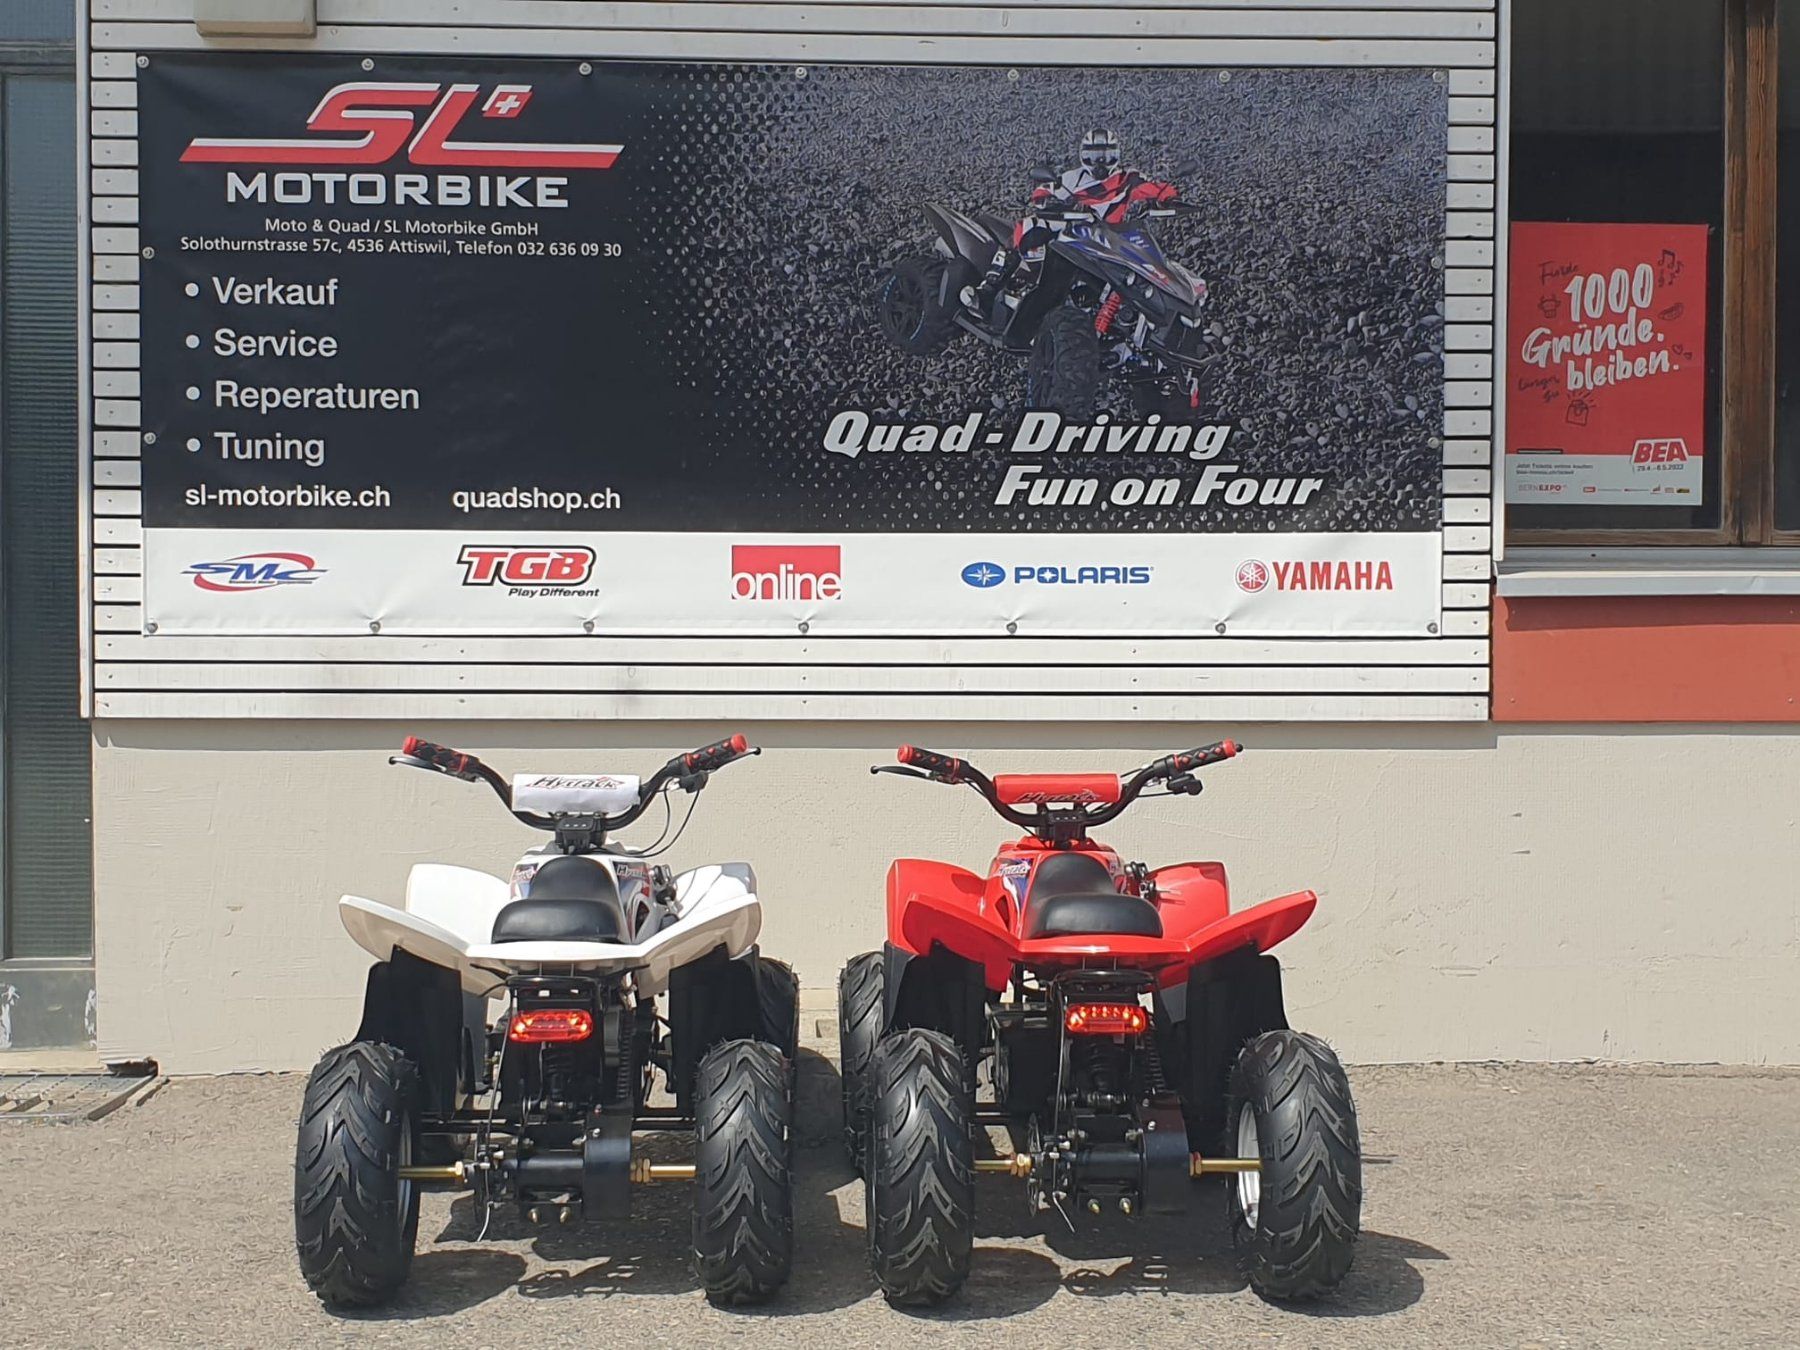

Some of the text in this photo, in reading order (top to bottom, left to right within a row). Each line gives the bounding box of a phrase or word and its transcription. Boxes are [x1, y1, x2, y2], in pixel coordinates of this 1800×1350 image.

[178, 82, 624, 169] SL
[227, 171, 569, 208] MOTORBIKE
[265, 218, 539, 236] Moto & Quad / SL Motorbike GmbH
[180, 236, 622, 257] Solothurnstrasse 57c, 4536 Attiswil, Telefon 032 636 09 30
[212, 276, 339, 306] Verkauf
[1563, 263, 1654, 322] 1000
[214, 328, 338, 358] Service
[1521, 306, 1664, 368] Gründe.
[1566, 349, 1680, 391] bleiben.
[215, 380, 420, 415] Reperaturen
[213, 431, 325, 467] Tuning
[823, 410, 981, 458] Quad
[1011, 412, 1231, 460] Driving
[1634, 442, 1688, 464] BEA
[185, 483, 391, 507] sl-motorbike.ch
[452, 486, 621, 514] quadshop.ch
[994, 465, 1323, 506] Fun on Four
[181, 562, 328, 581] SMC
[466, 551, 590, 581] TGB
[1015, 566, 1149, 584] POLARIS
[1273, 561, 1393, 590] YAMAHA
[508, 588, 600, 598] Play Different
[731, 563, 841, 600] online
